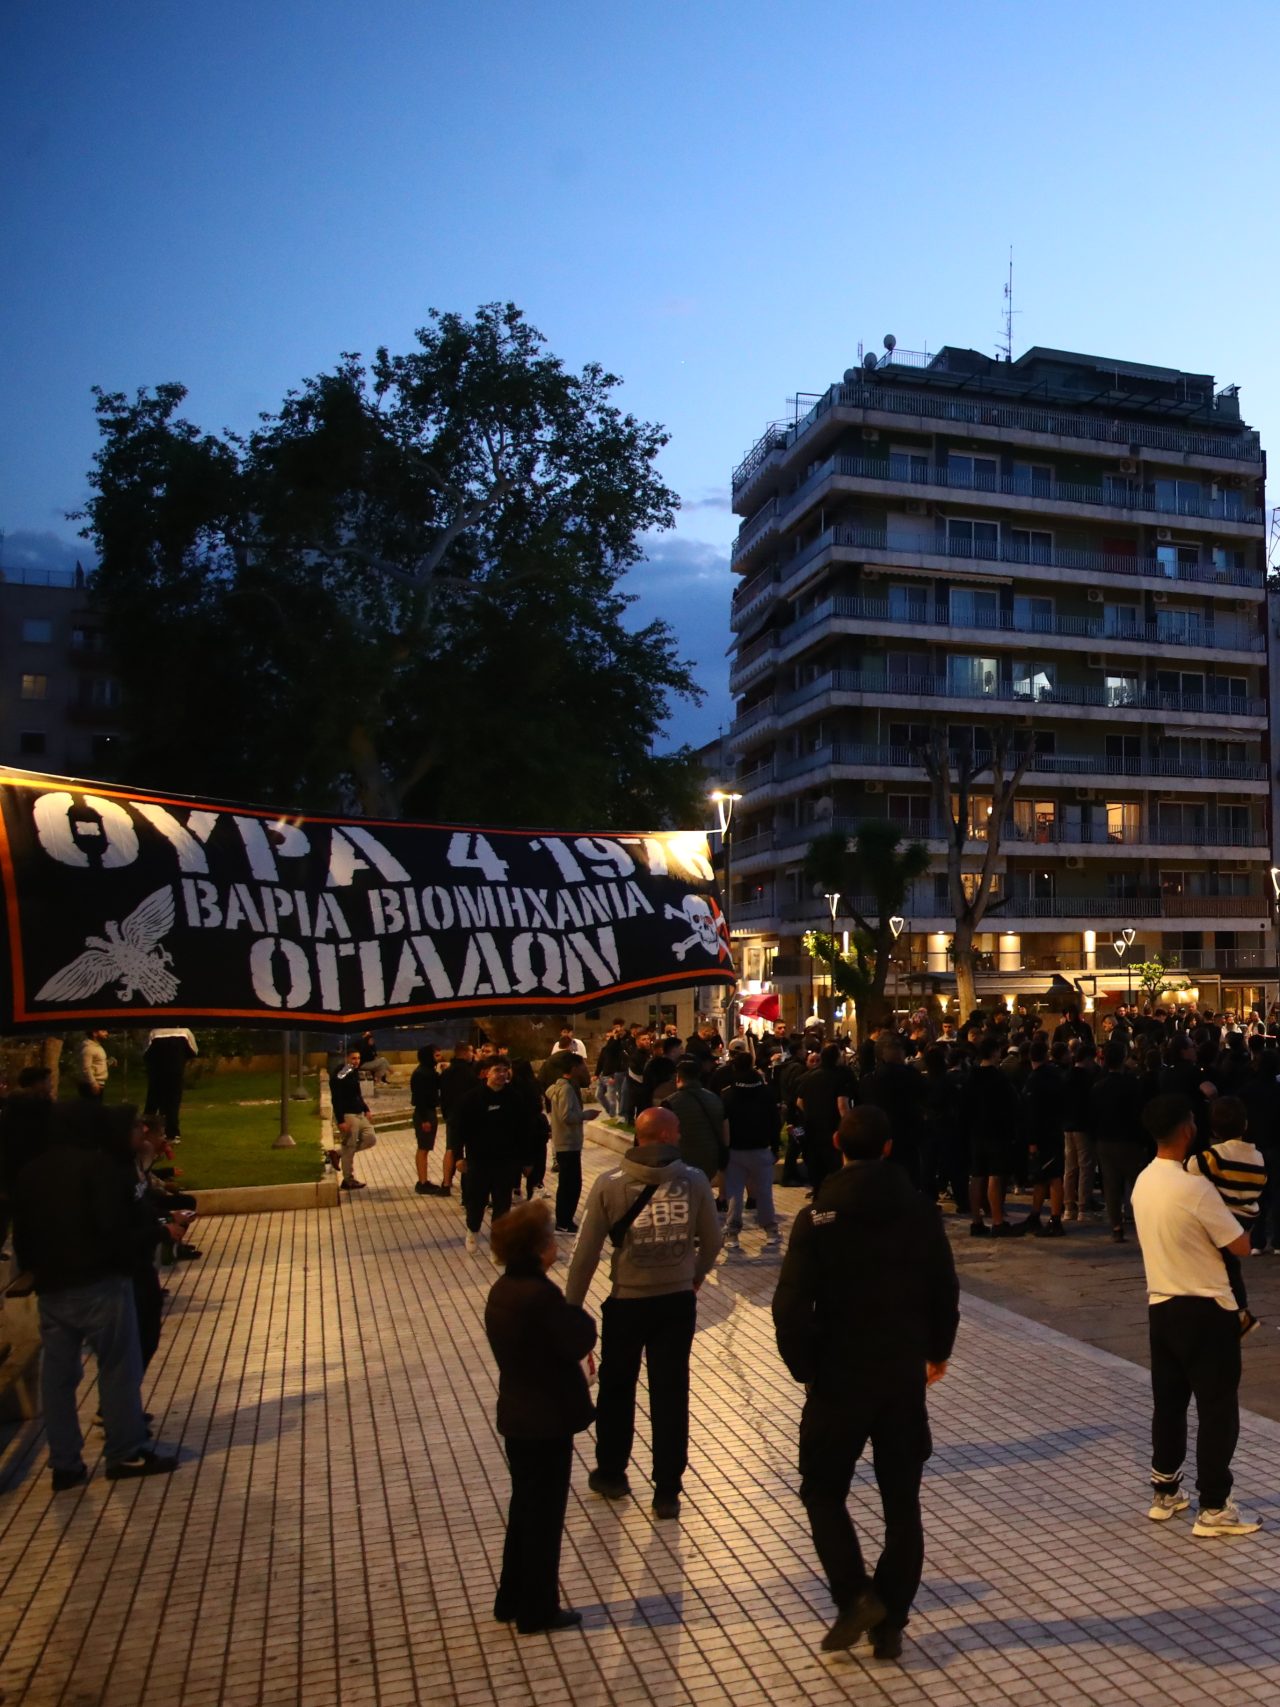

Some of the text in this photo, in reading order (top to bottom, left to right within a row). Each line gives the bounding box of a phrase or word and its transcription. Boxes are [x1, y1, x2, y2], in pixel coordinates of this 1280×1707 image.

[33, 791, 412, 888] ΘΥΡΑ
[446, 831, 510, 882] 4
[180, 877, 656, 939] ΒΑΡΙΑ ΒΙΟΜΗΧΑΝΙΑ
[250, 925, 621, 1012] ΟΠΑΔΩΝ
